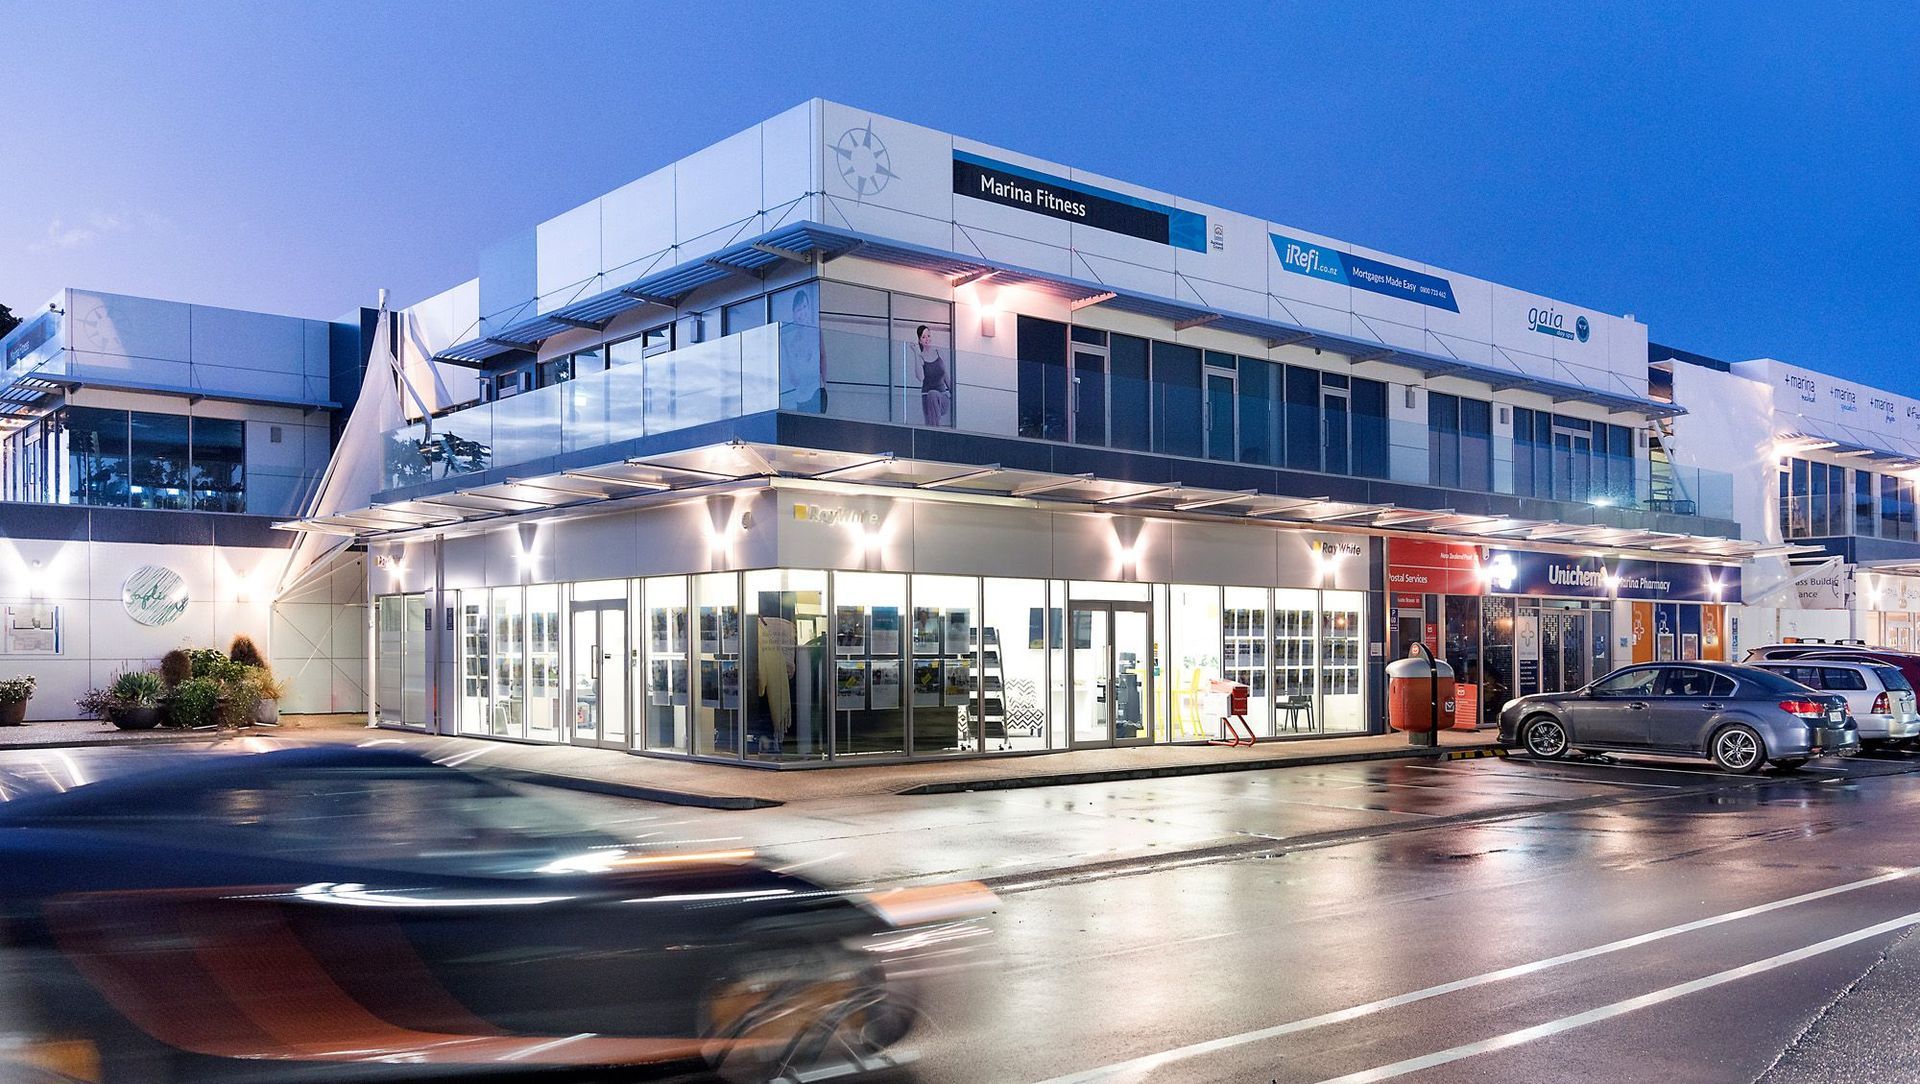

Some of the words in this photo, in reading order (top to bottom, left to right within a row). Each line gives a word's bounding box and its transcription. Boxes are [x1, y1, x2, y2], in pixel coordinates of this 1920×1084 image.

[981, 174, 1032, 204] Marina
[1036, 188, 1086, 217] Fitness
[1352, 266, 1385, 284] Mortgages
[1385, 275, 1403, 288] Made
[1403, 279, 1417, 293] Easy
[1528, 307, 1564, 331] gaia
[1405, 574, 1428, 584] Services
[1548, 564, 1602, 587] Unichem
[1640, 577, 1670, 593] Pharmacy
